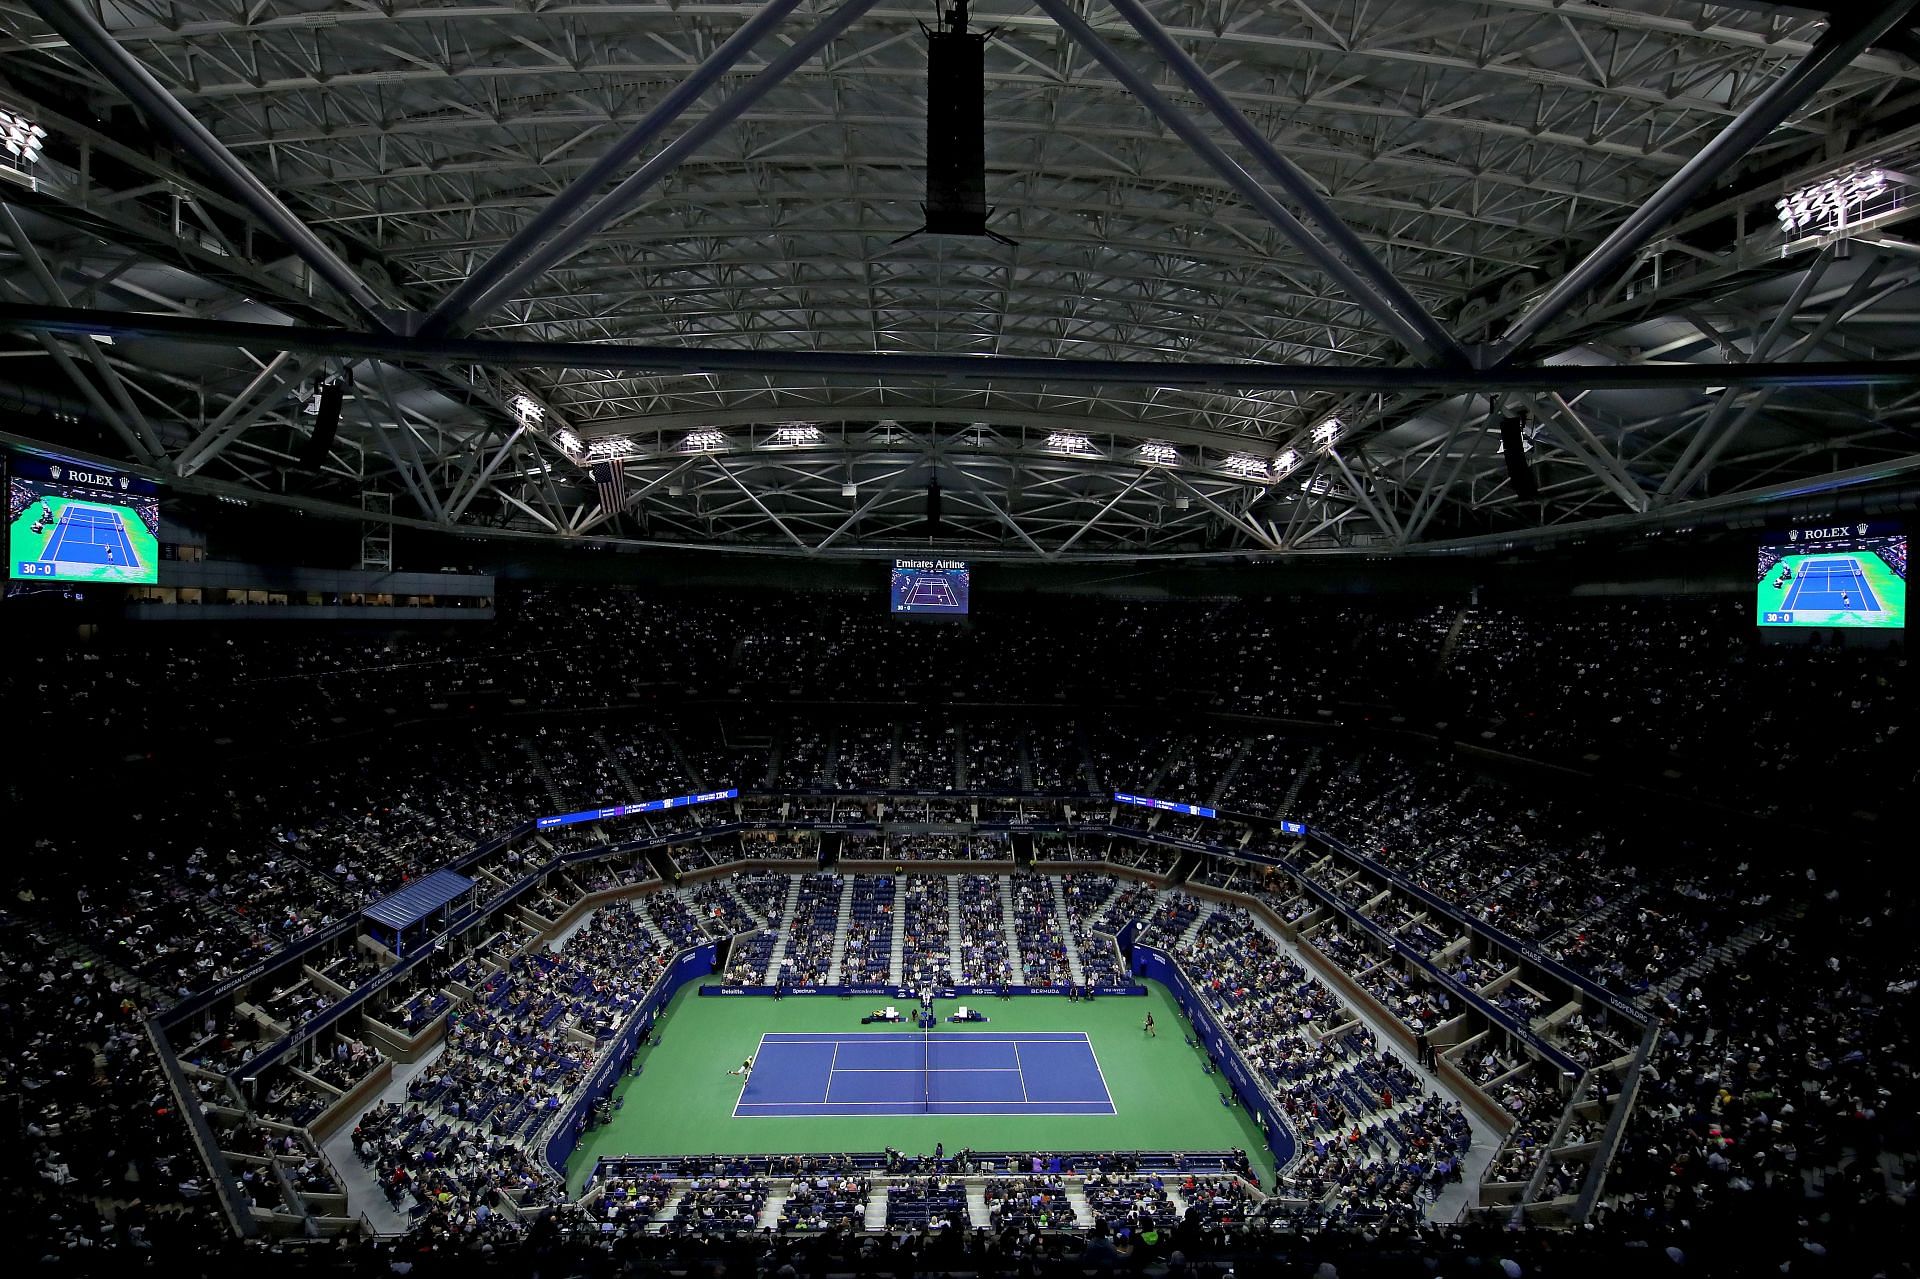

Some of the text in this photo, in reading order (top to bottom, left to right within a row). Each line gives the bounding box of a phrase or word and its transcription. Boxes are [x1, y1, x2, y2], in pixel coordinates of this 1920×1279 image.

[69, 470, 114, 487] ROLEX
[1804, 527, 1851, 540] ROLEX
[24, 563, 36, 574] 30
[45, 565, 51, 575] 0
[896, 559, 965, 569] Emirates Airline
[1767, 613, 1777, 622] 30
[1783, 613, 1790, 622] 0
[716, 791, 728, 799] IBM
[1521, 947, 1542, 964] CHASE
[214, 965, 265, 996] AMERICAN EXPRESS
[1610, 996, 1648, 1023] USOPEN.ORG
